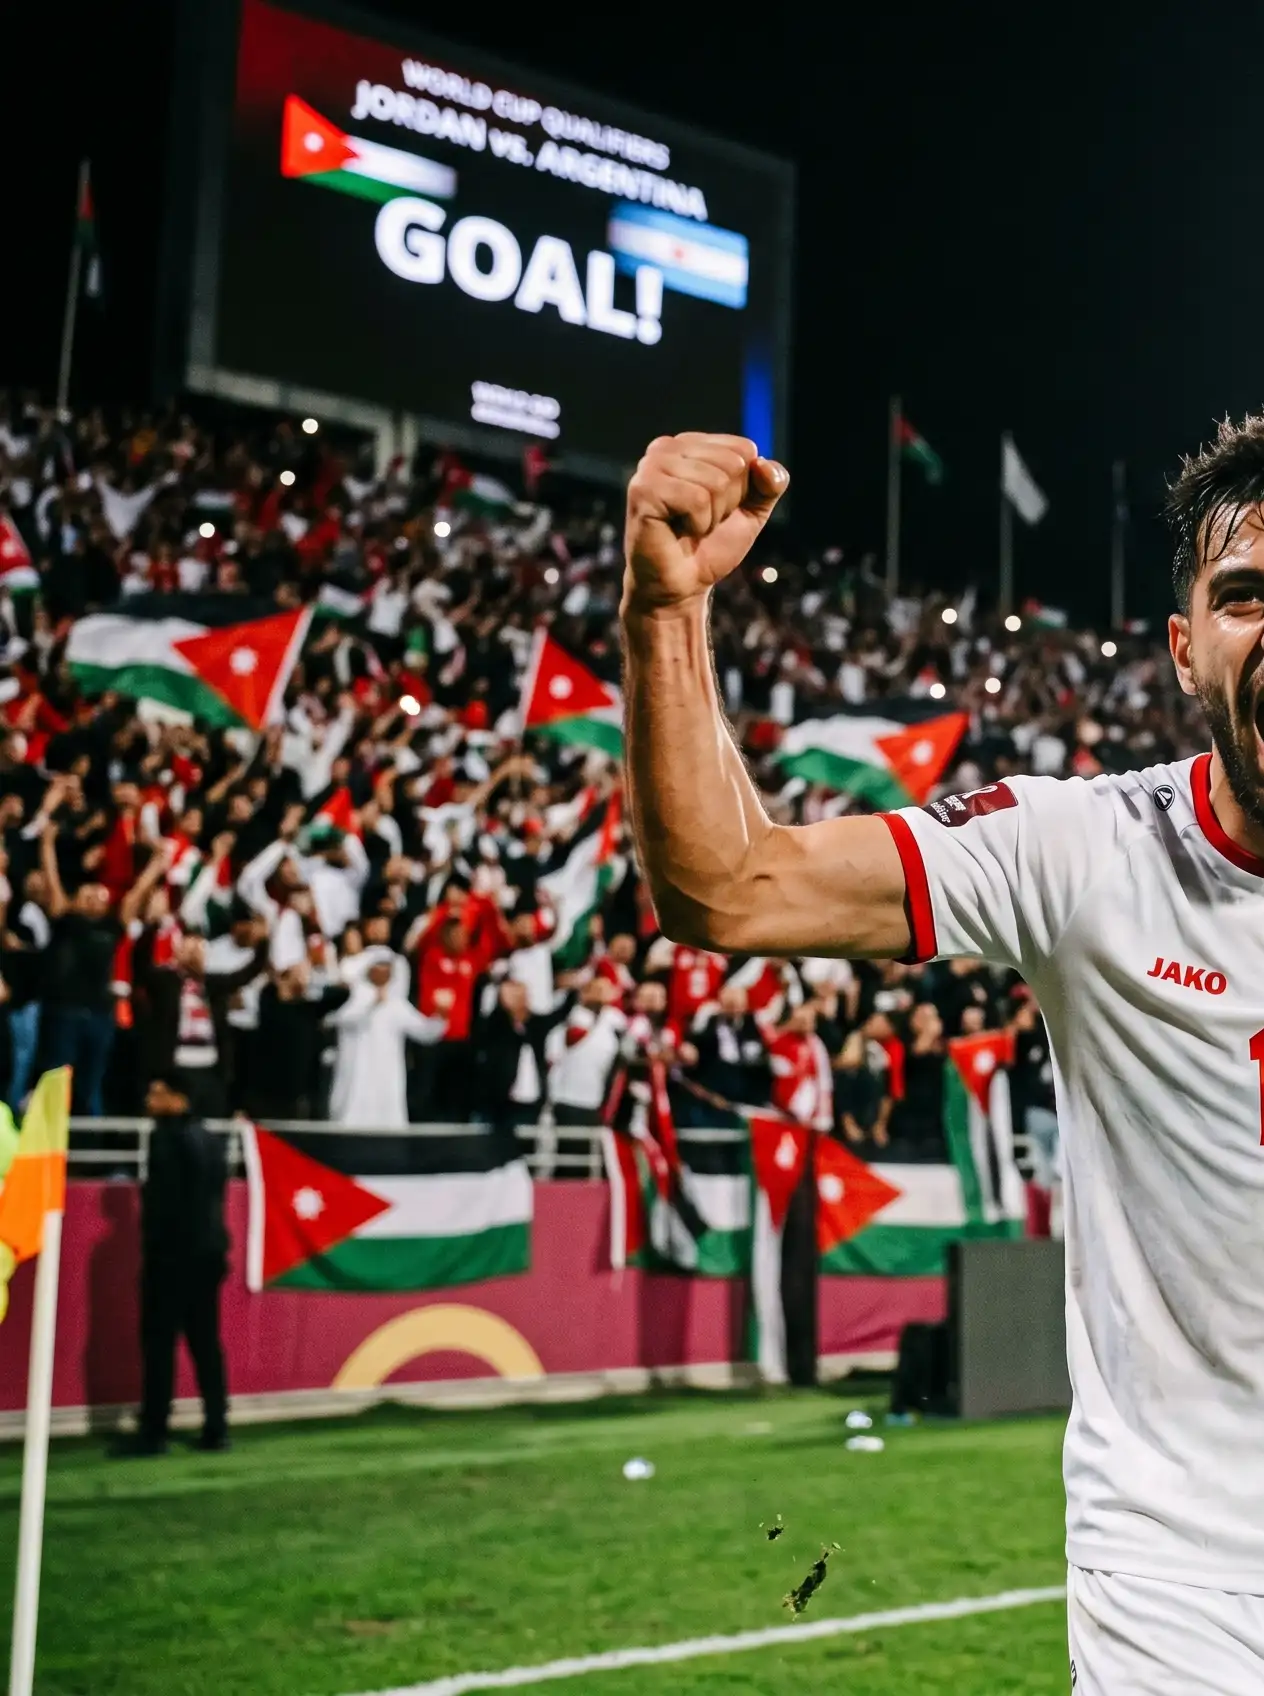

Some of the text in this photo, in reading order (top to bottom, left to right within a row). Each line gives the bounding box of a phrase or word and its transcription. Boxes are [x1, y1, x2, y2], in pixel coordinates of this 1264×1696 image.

[402, 58, 493, 110] WORLD
[492, 90, 542, 126] CUP
[351, 79, 487, 152] JORDAN
[535, 140, 708, 221] ARGENTINA
[375, 197, 664, 345] GOAL!
[1147, 957, 1227, 995] JAKO
